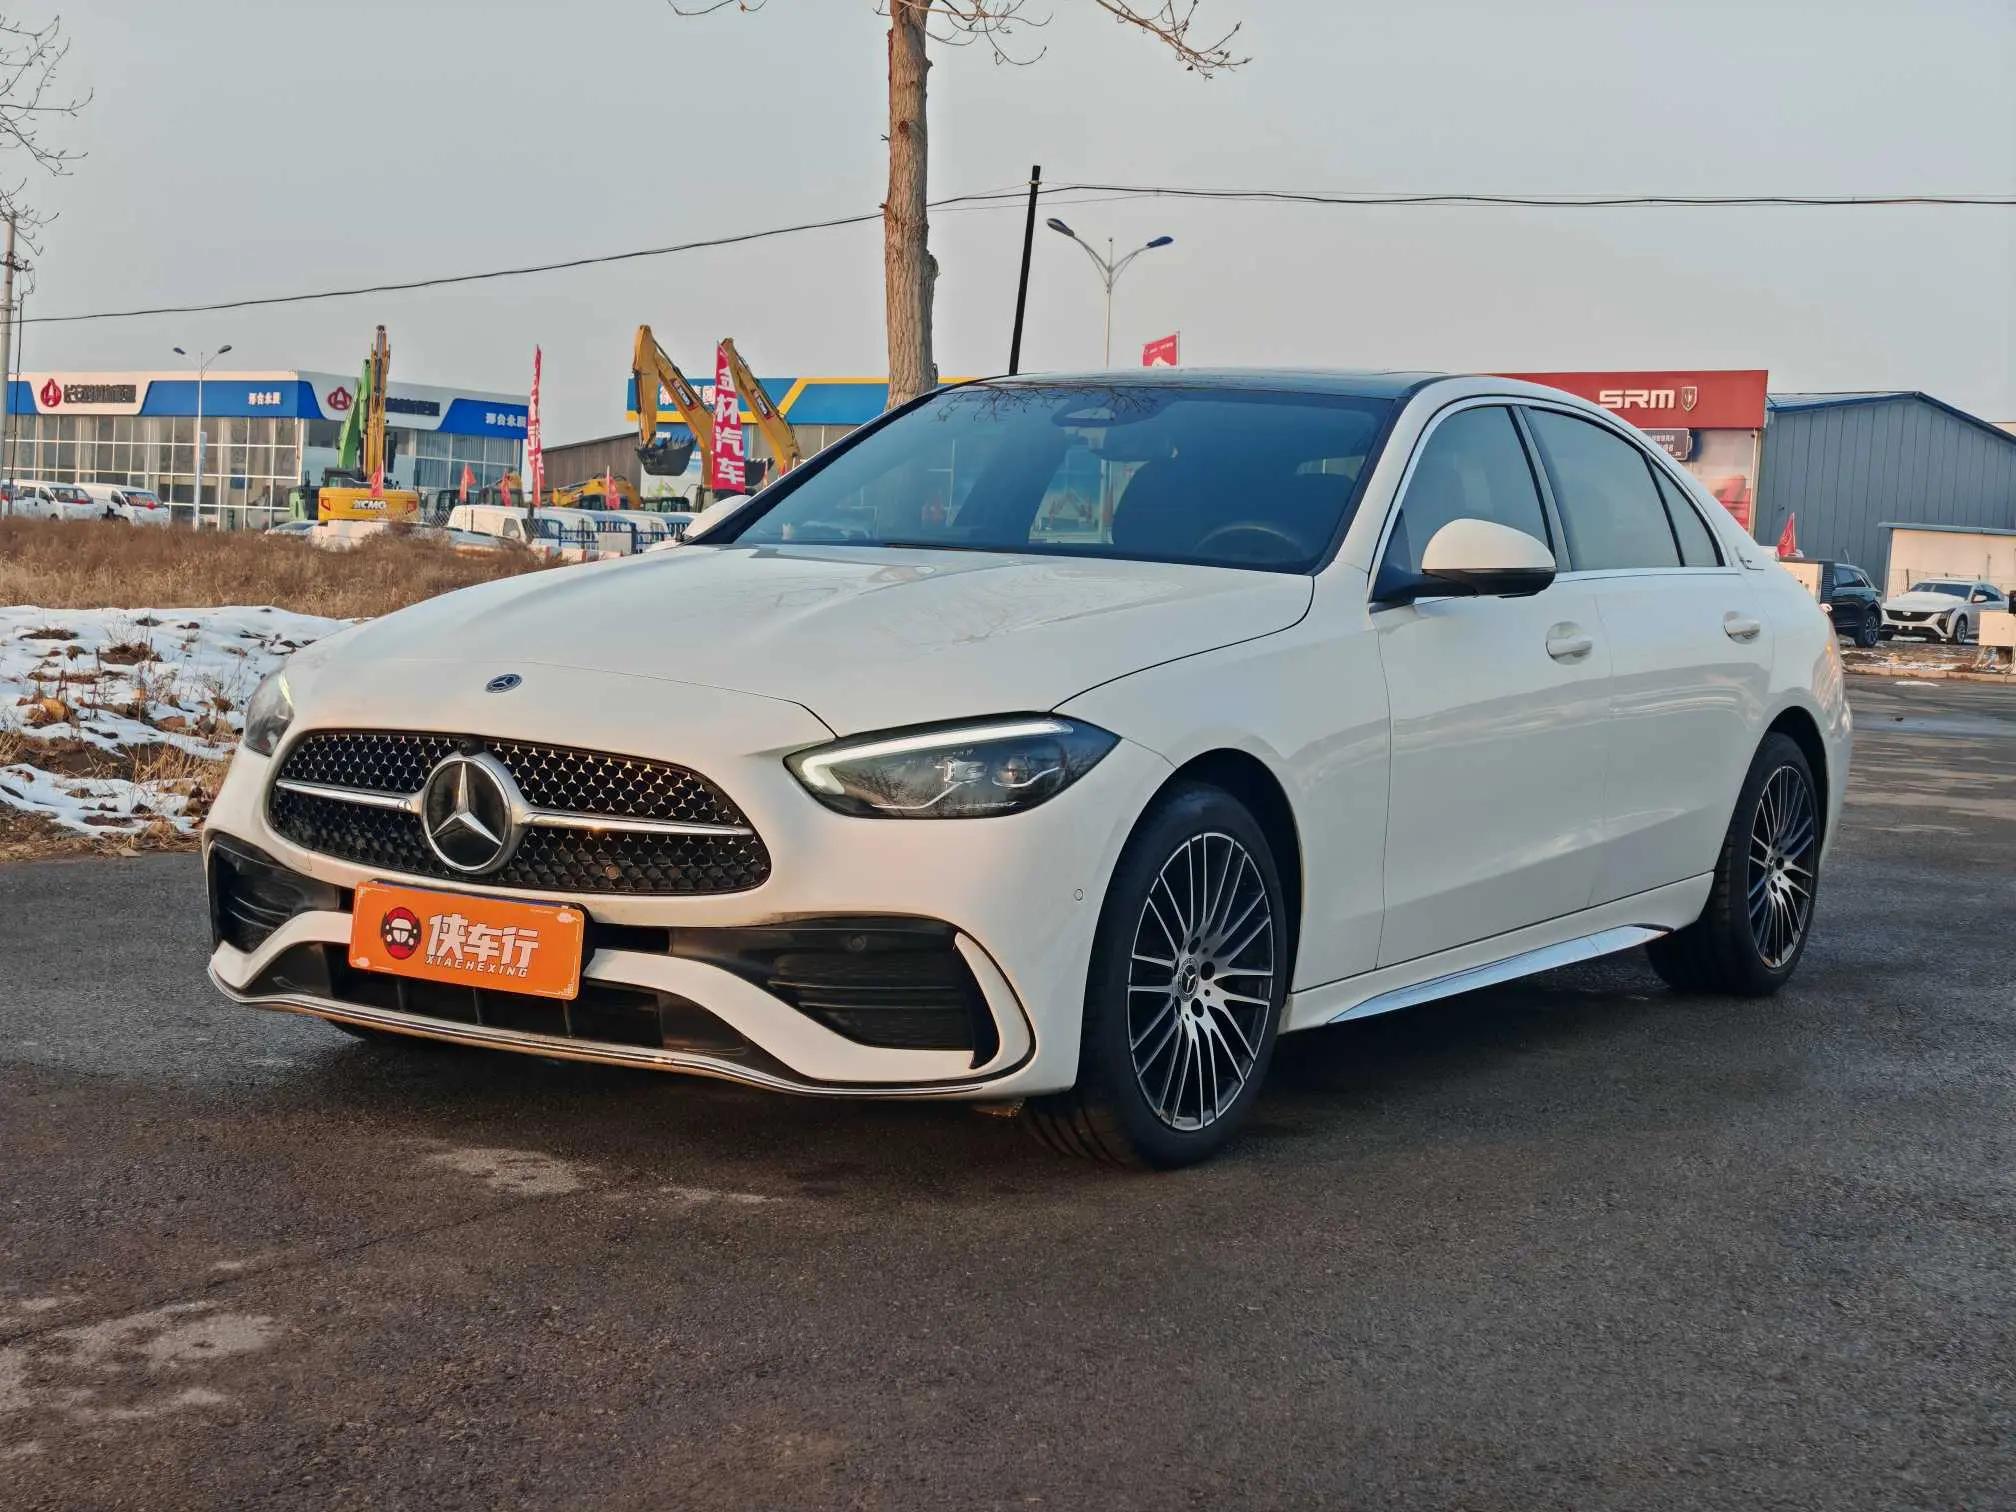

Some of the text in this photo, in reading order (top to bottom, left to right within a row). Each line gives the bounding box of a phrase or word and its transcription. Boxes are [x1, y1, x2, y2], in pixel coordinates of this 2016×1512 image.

[1600, 389, 1675, 409] SRM
[716, 367, 745, 484] 金杯汽车
[427, 914, 538, 967] 侠车行
[425, 954, 529, 978] XIACHEXING
